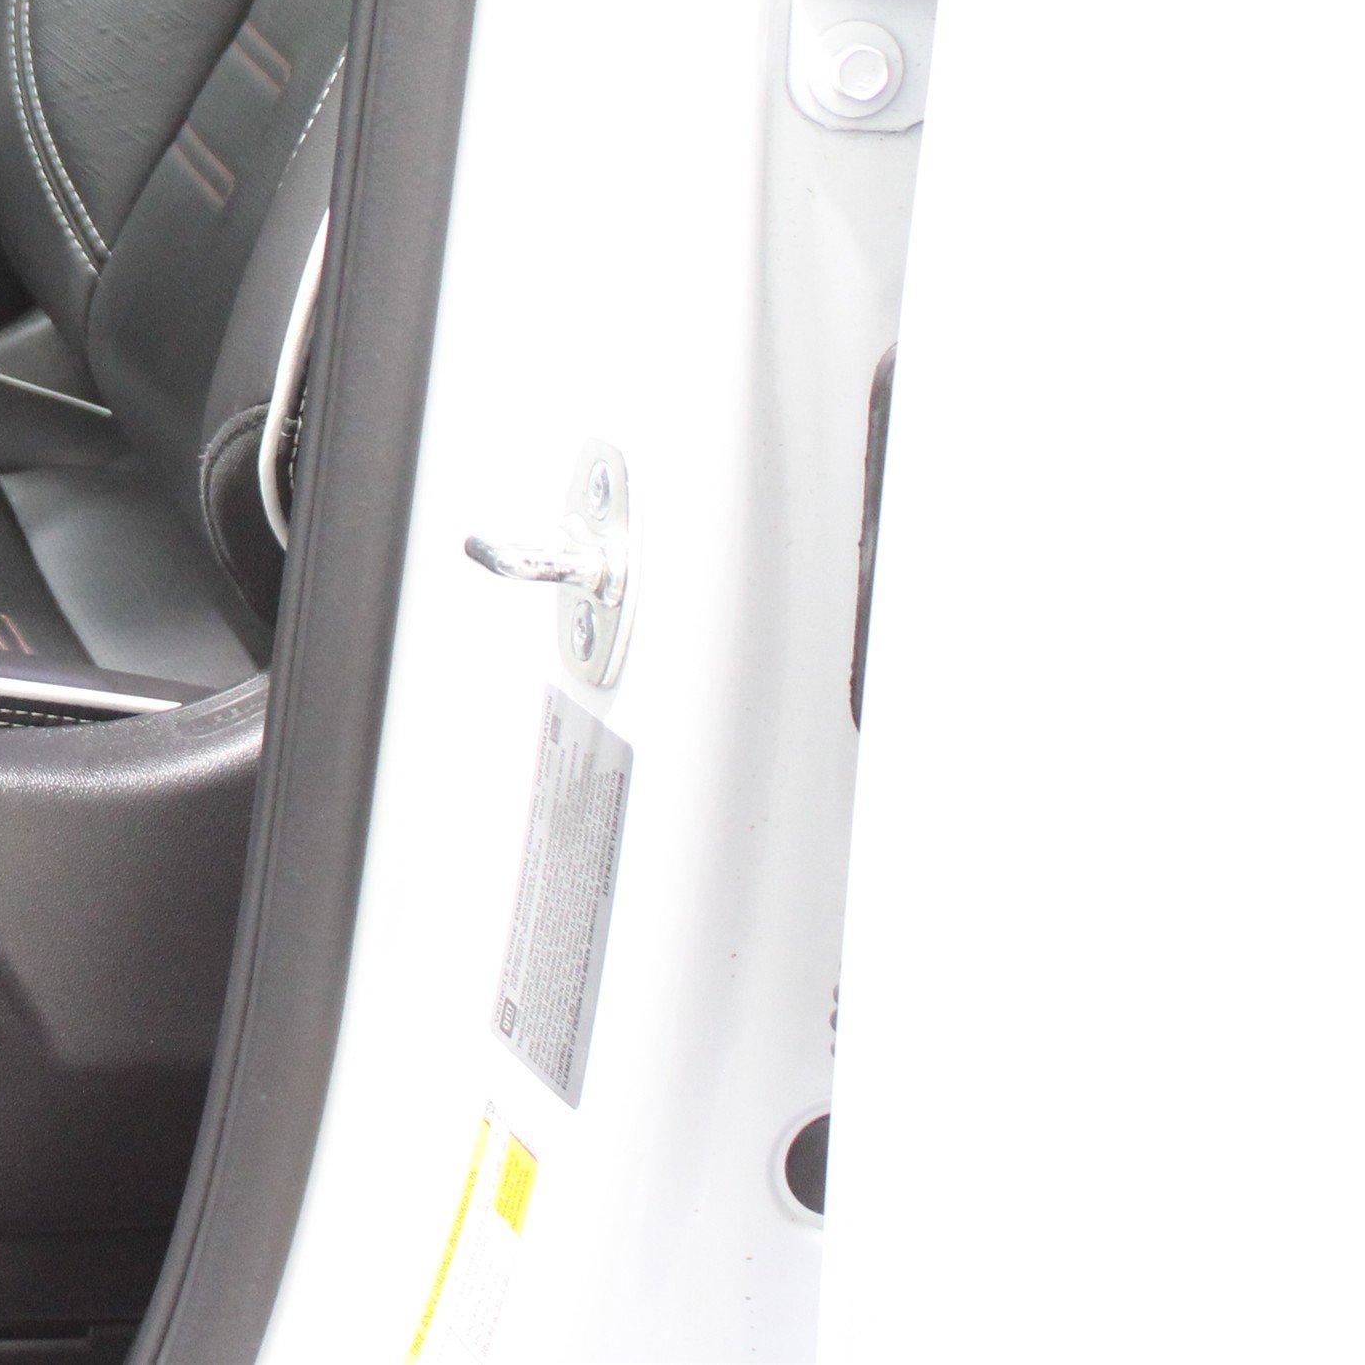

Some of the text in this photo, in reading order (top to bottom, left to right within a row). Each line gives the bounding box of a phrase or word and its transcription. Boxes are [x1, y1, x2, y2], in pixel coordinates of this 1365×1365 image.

[493, 966, 509, 1024] VEHICLE
[505, 922, 517, 966] NOISE
[513, 855, 529, 922] EMISSION
[524, 791, 540, 855] CONTROL
[536, 693, 553, 788] INFORMATION
